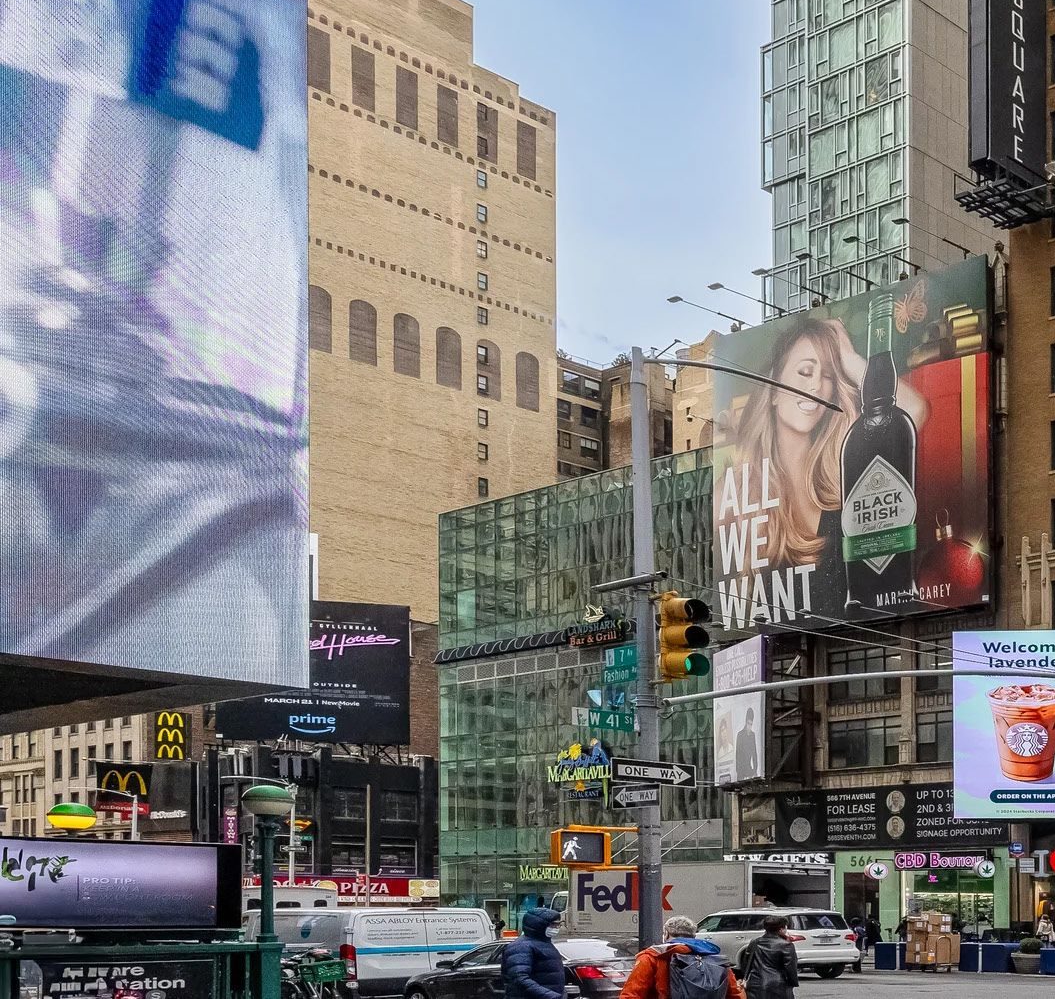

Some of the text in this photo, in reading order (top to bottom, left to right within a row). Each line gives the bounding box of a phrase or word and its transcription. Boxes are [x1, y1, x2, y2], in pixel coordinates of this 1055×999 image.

[718, 457, 780, 520] ALL
[853, 491, 903, 512] BLACK
[857, 505, 899, 524] IRISH
[718, 514, 769, 576] WE
[717, 563, 817, 633] WANT
[919, 583, 951, 600] CAREY
[567, 620, 617, 636] LANDSHARK
[569, 631, 617, 646] Bar & Grill
[327, 633, 388, 660] House
[619, 650, 625, 662] 7
[604, 669, 629, 682] Fashion
[289, 713, 336, 725] prime
[590, 712, 633, 727] W 41 St
[547, 765, 611, 783] MARGARITAVILL
[625, 766, 684, 780] ONE WAY
[619, 791, 654, 802] ONE WAY
[916, 790, 929, 799] UP
[931, 790, 944, 799] TO
[827, 803, 876, 815] FOR LEASE
[916, 804, 935, 814] 2ND
[937, 803, 943, 812] &
[916, 817, 945, 827] ZONED
[916, 827, 1002, 838] SIGNAGE OPPORTUNITY
[767, 853, 829, 864] GIFTS
[894, 852, 928, 869] CBD
[1033, 850, 1050, 878] I
[112, 877, 136, 885] TIP:
[340, 882, 390, 894] PIZZA
[448, 916, 477, 925] Systems
